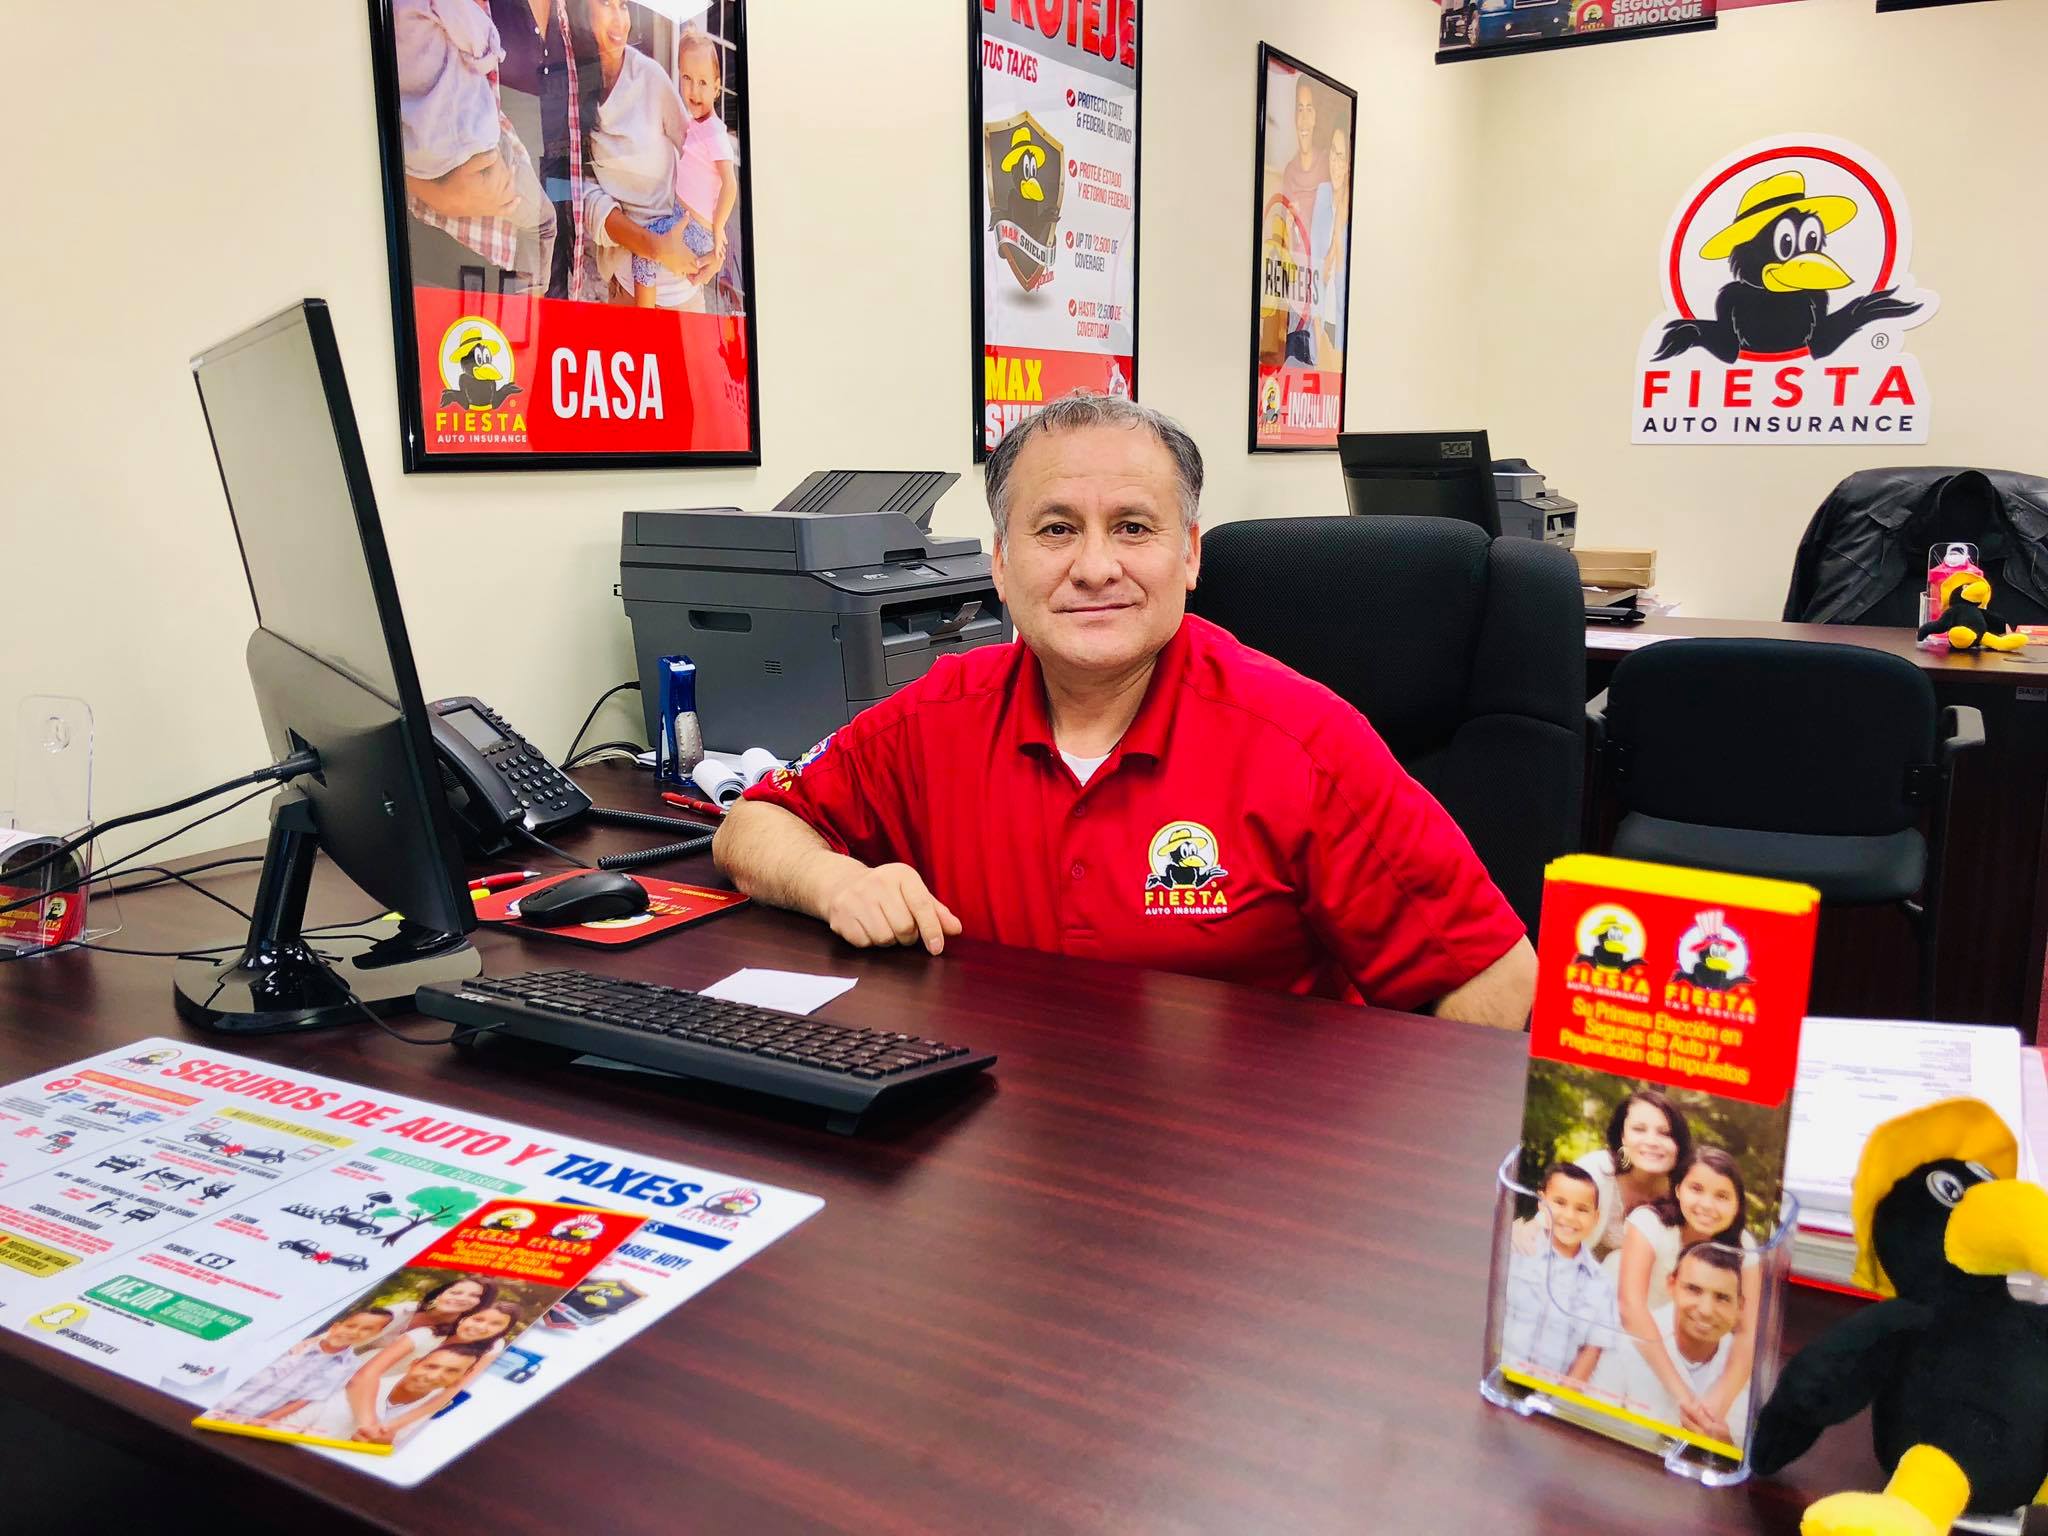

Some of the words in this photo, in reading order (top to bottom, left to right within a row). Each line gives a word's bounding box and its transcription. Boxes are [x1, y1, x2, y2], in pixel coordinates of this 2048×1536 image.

[1614, 4, 1701, 27] REMOLQUE
[982, 0, 1135, 69] ROTEJE
[984, 40, 1003, 71] TUS
[1007, 48, 1037, 83] TAXES
[1078, 92, 1107, 115] PROTECTS
[1108, 101, 1123, 120] STATE
[1077, 113, 1081, 127] &
[1082, 115, 1106, 136] FEDERAL
[1080, 163, 1102, 183] PROTEJE
[1103, 171, 1121, 188] ESTADO
[1078, 184, 1082, 197] Y
[1082, 186, 1107, 204] RETORNO
[1001, 225, 1018, 242] MAX
[1020, 235, 1045, 262] SHIELD
[1076, 232, 1084, 247] UP
[1085, 234, 1092, 248] TO
[1075, 253, 1105, 272] COVERAGE!
[1265, 258, 1319, 305] RENTERS
[1079, 300, 1096, 318] HASTA
[1114, 307, 1121, 320] DE
[551, 347, 664, 420] CASA
[985, 356, 1042, 401] MAX
[1642, 366, 1915, 408] FIESTA
[436, 412, 526, 432] FIESTA
[1288, 392, 1339, 429] INQUILINO
[1642, 416, 1718, 433] AUTO
[1733, 415, 1913, 432] INSURANCE
[438, 434, 465, 443] AUTO
[469, 434, 527, 443] INSURANCE
[1145, 891, 1227, 906] FIESTA
[1146, 907, 1170, 915] AUTO
[1174, 906, 1227, 914] INSURANCE
[1565, 965, 1650, 995] FIESTA
[1664, 984, 1756, 1015] FIESTA
[1572, 999, 1593, 1018] Su
[1595, 1002, 1651, 1028] Primera
[1655, 1012, 1717, 1040] Elección
[1720, 1029, 1742, 1046] en
[1584, 1018, 1644, 1045] Seguros
[1647, 1029, 1666, 1048] de
[1669, 1032, 1706, 1054] Auto
[1559, 1029, 1644, 1060] Preparación
[1646, 1047, 1666, 1067] de
[1669, 1051, 1749, 1085] Impuestos
[163, 1061, 339, 1110] SEGUROS
[327, 1101, 400, 1126] DE
[385, 1118, 510, 1155] AUTO
[506, 1144, 555, 1166] Y
[548, 1155, 701, 1206] TAXES
[379, 1152, 436, 1169] INTEGRAL
[653, 1254, 691, 1268] HOY!
[98, 1278, 172, 1310] MEJOR
[179, 1364, 204, 1373] yelp
